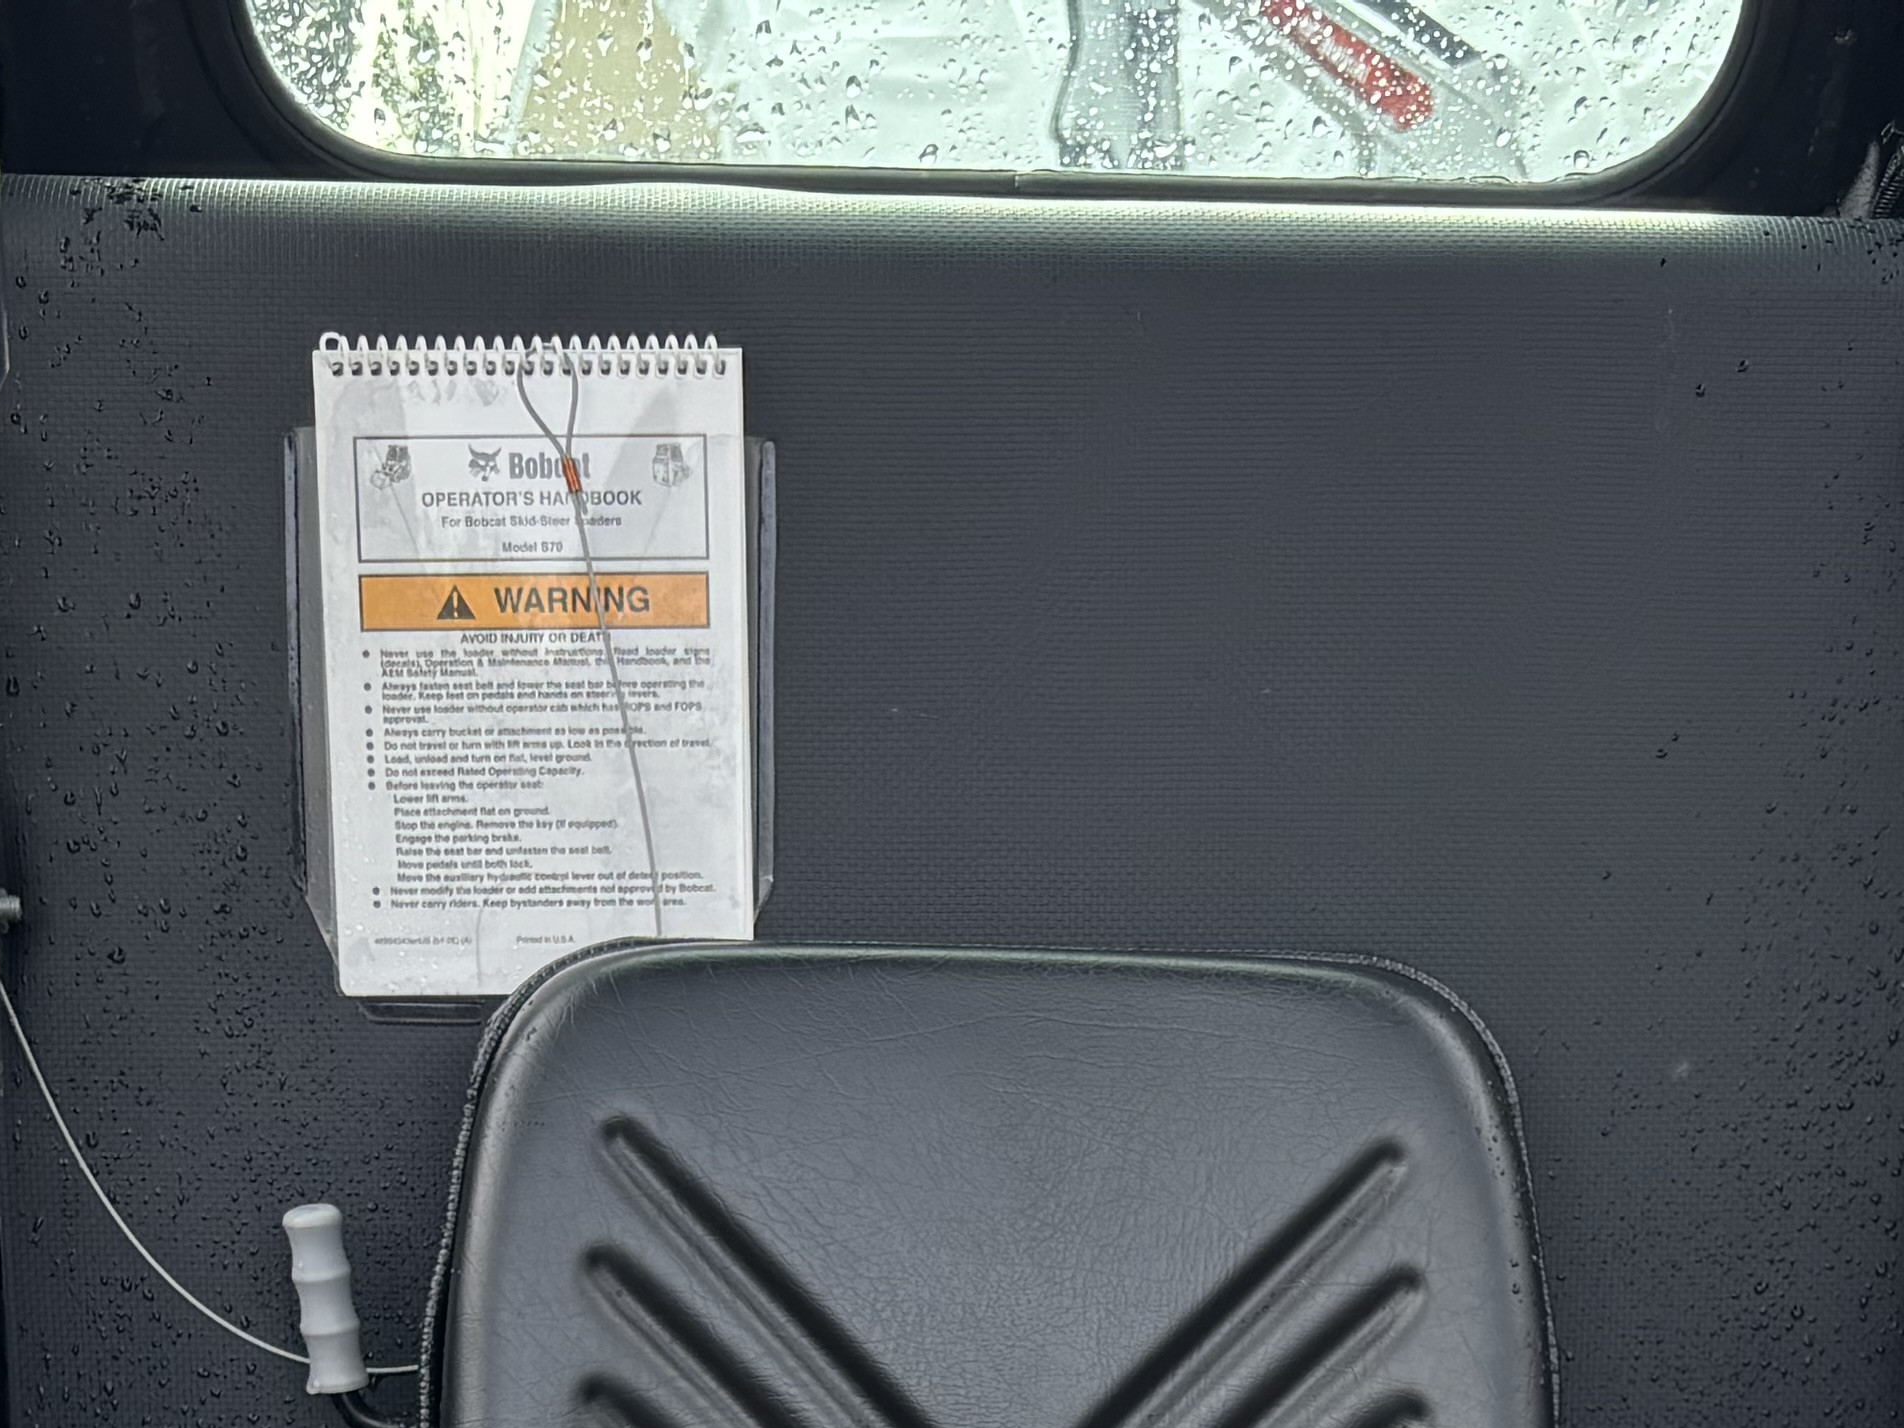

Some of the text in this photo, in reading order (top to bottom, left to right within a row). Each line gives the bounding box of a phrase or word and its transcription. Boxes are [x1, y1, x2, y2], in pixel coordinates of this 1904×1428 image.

[422, 491, 534, 507] OPERATOR'S
[465, 516, 506, 527] Bobcat
[502, 542, 536, 553] Model
[494, 586, 651, 613] WARNING
[461, 633, 496, 643] AVOID
[501, 633, 544, 643] INJURY
[549, 633, 567, 642] OR
